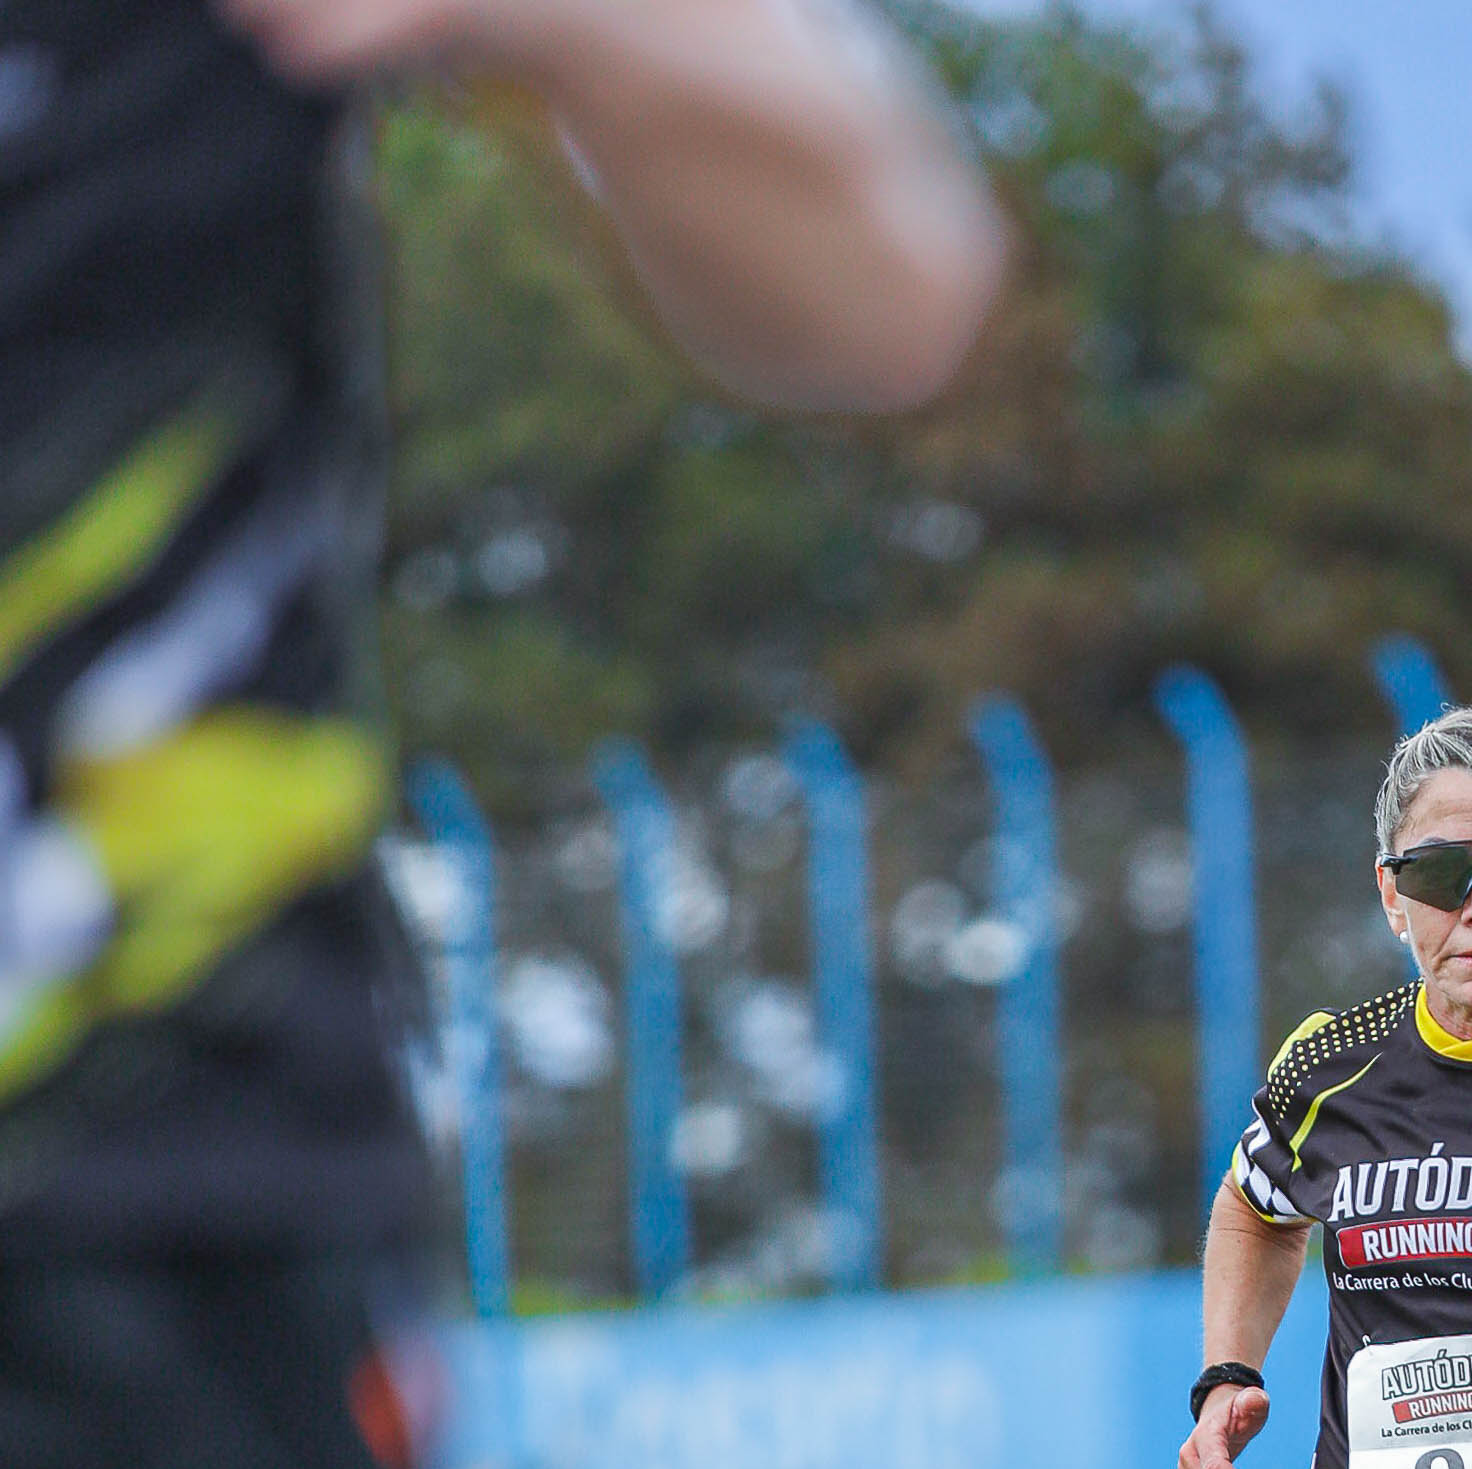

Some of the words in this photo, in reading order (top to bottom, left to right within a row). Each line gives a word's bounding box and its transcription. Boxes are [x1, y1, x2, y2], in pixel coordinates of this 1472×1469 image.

[1345, 1273, 1400, 1291] Carrera
[1402, 1272, 1423, 1288] de
[1424, 1272, 1449, 1287] los
[1381, 1427, 1393, 1438] La
[1395, 1426, 1430, 1436] Carrera
[1432, 1422, 1444, 1432] de
[1447, 1421, 1461, 1432] los
